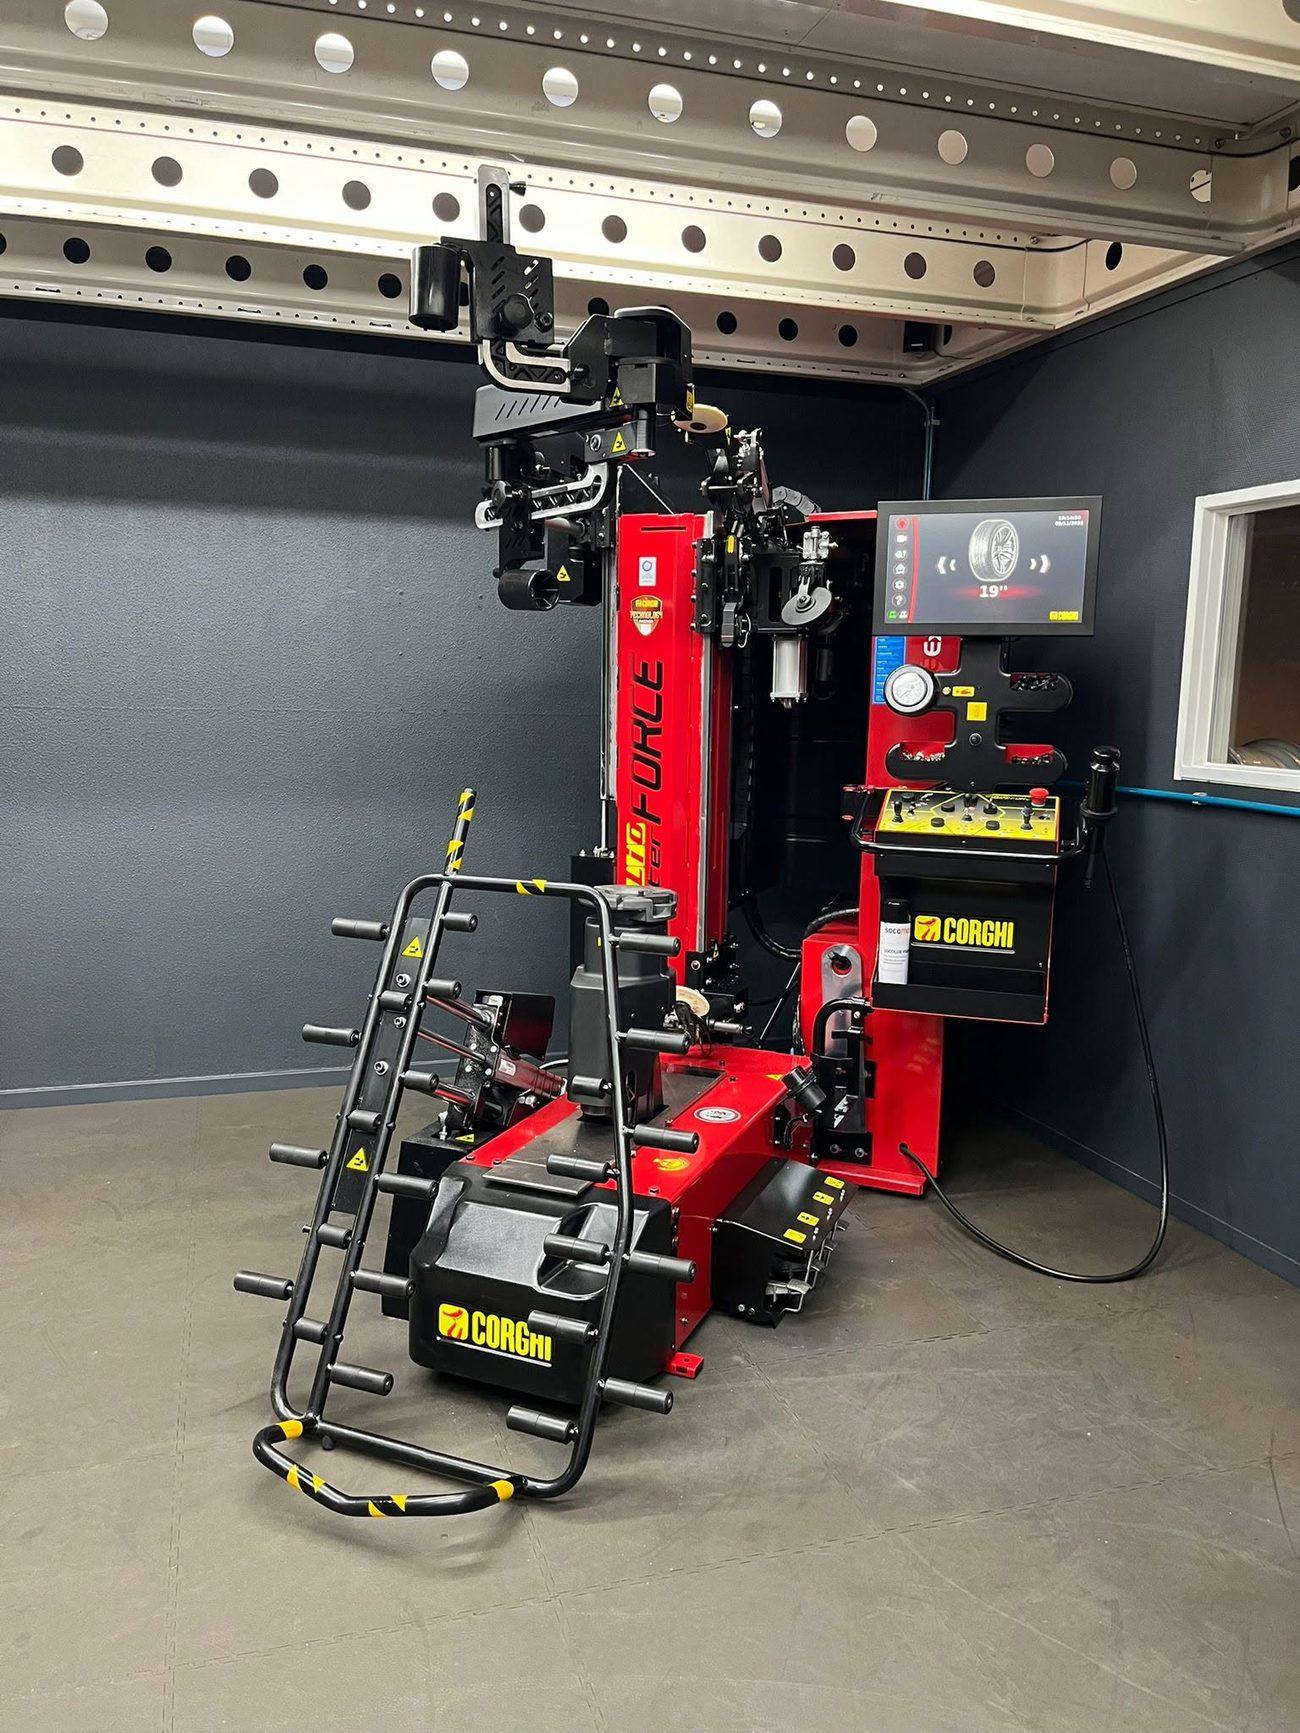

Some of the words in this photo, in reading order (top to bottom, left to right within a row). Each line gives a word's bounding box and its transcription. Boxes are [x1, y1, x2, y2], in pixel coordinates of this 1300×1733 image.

[631, 652, 664, 826] FORCE
[943, 916, 1015, 949] CORGHI
[471, 1310, 552, 1362] CORGHI
